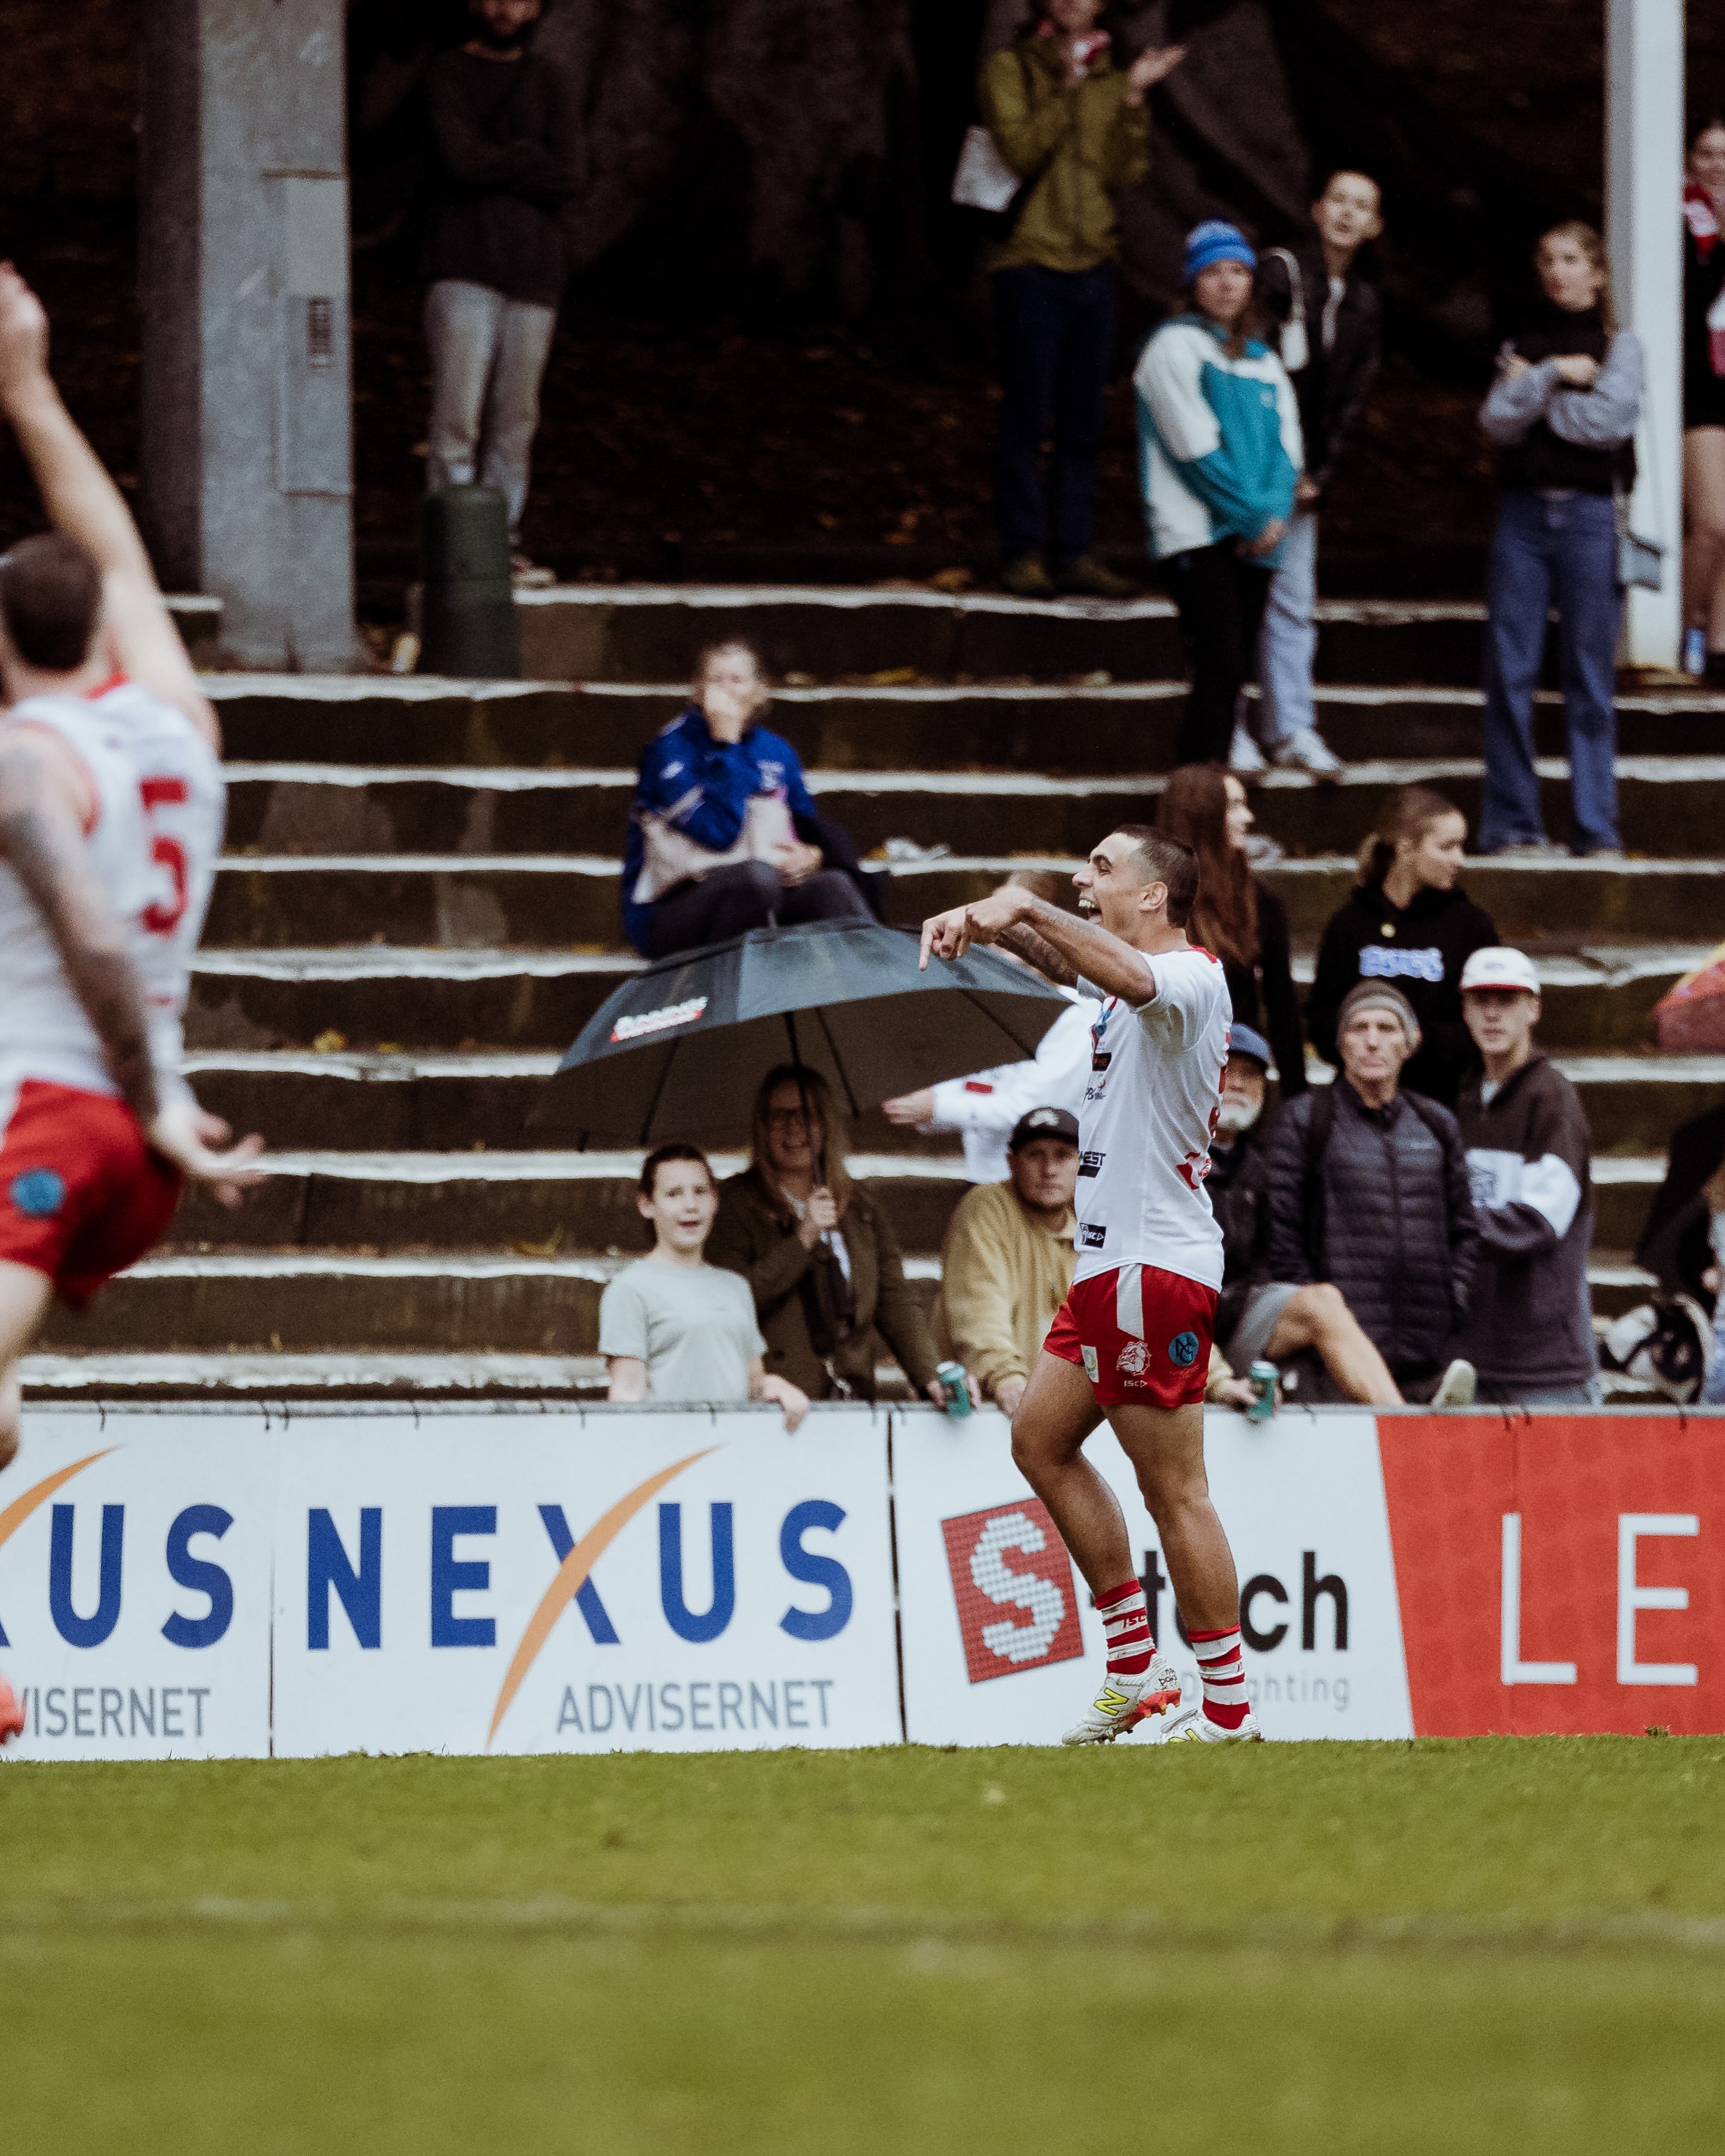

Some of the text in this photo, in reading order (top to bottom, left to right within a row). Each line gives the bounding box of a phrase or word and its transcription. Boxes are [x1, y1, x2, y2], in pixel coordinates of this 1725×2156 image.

[1078, 1151, 1106, 1166] EST
[0, 1503, 235, 1649] US
[308, 1499, 854, 1651] NEXUS
[1501, 1512, 1700, 1685] LE
[556, 1680, 834, 1734] ADVISERNET
